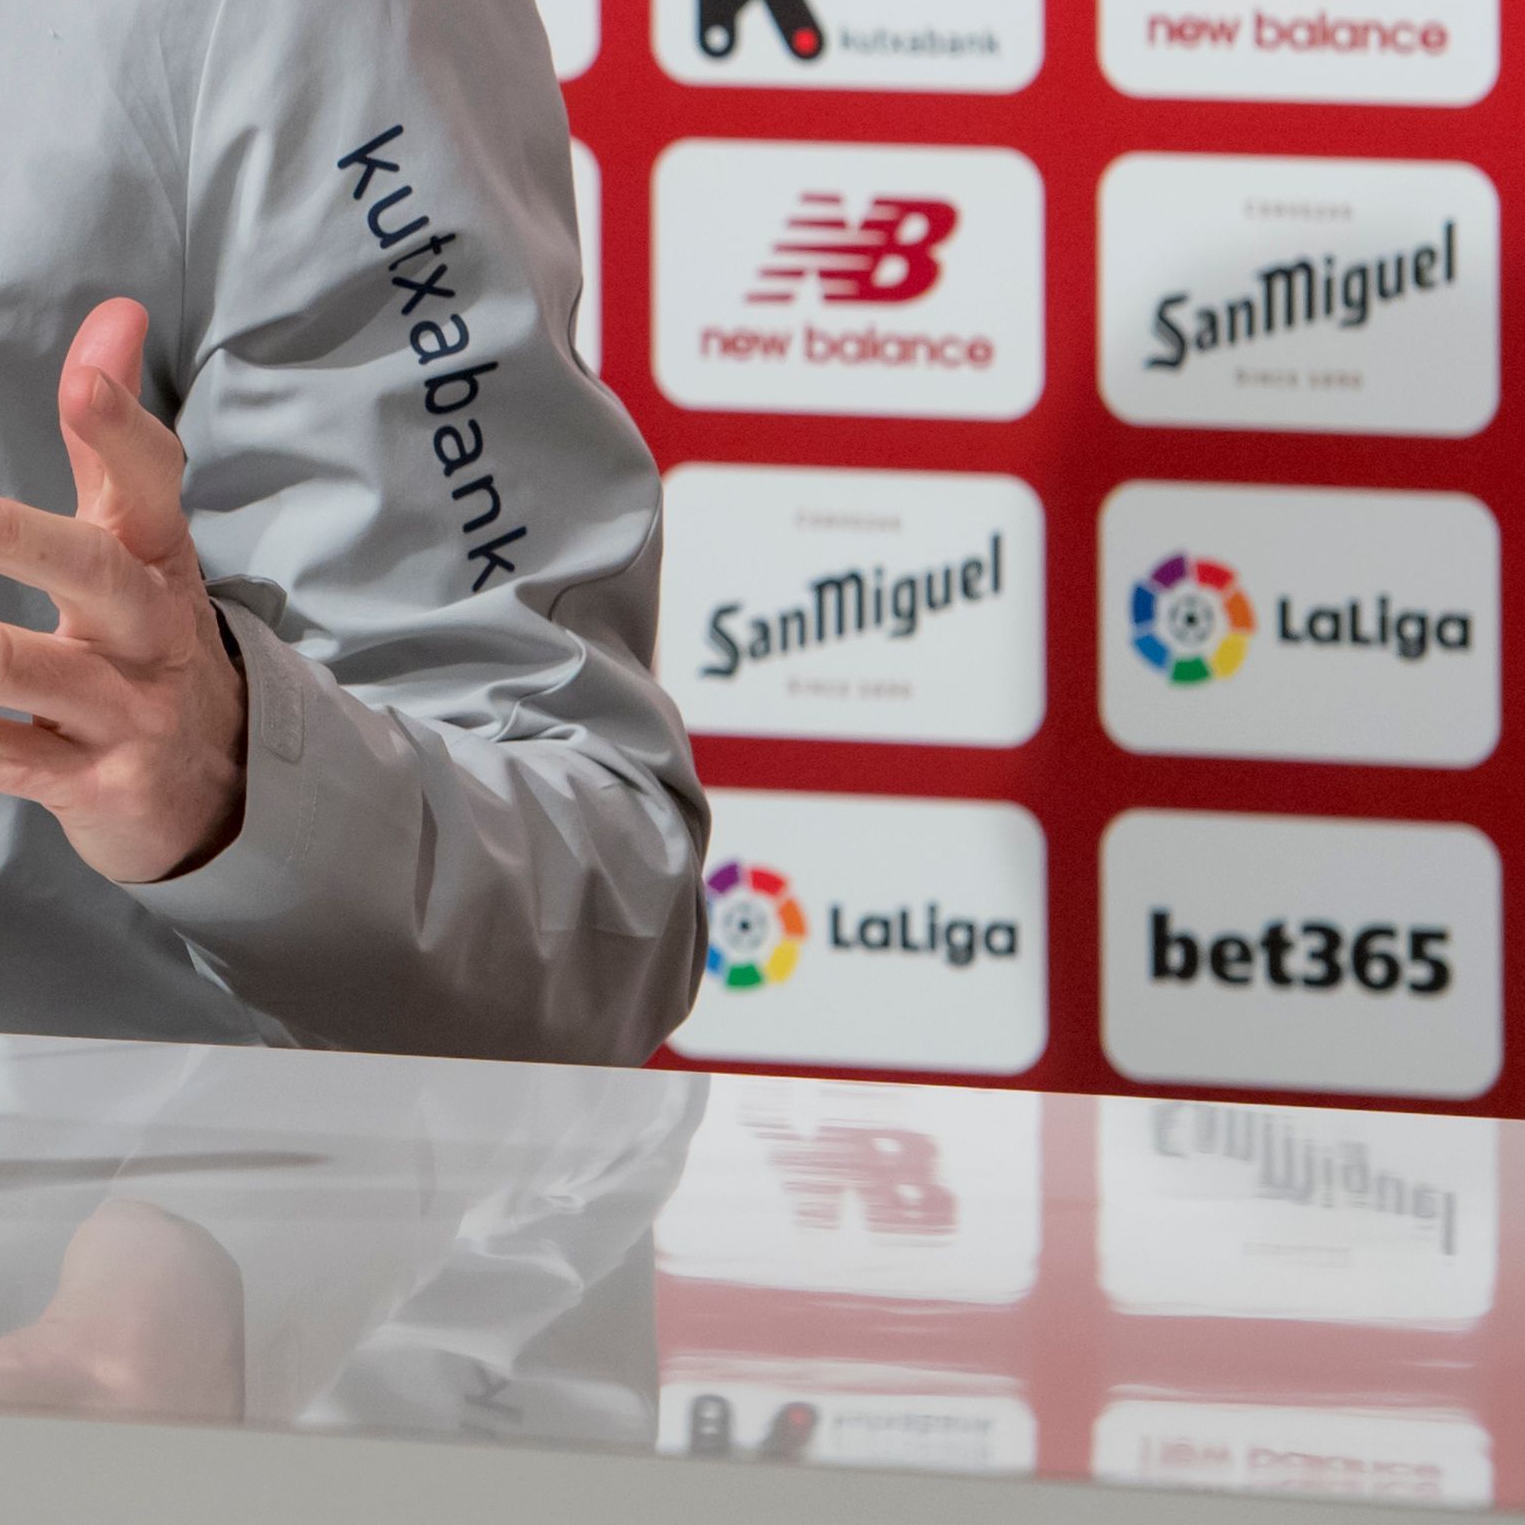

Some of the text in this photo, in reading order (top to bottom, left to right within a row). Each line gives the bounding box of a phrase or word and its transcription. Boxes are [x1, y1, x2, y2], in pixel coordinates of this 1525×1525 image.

[1147, 10, 1449, 56] new balance
[1142, 217, 1463, 373] SanMiguel
[337, 124, 527, 592] kutxabank
[700, 325, 996, 370] new balance
[700, 533, 1006, 683] SanMiguel
[1277, 595, 1473, 662] LaLiga
[829, 902, 1019, 969] LaLiga
[1149, 908, 1452, 998] bet365
